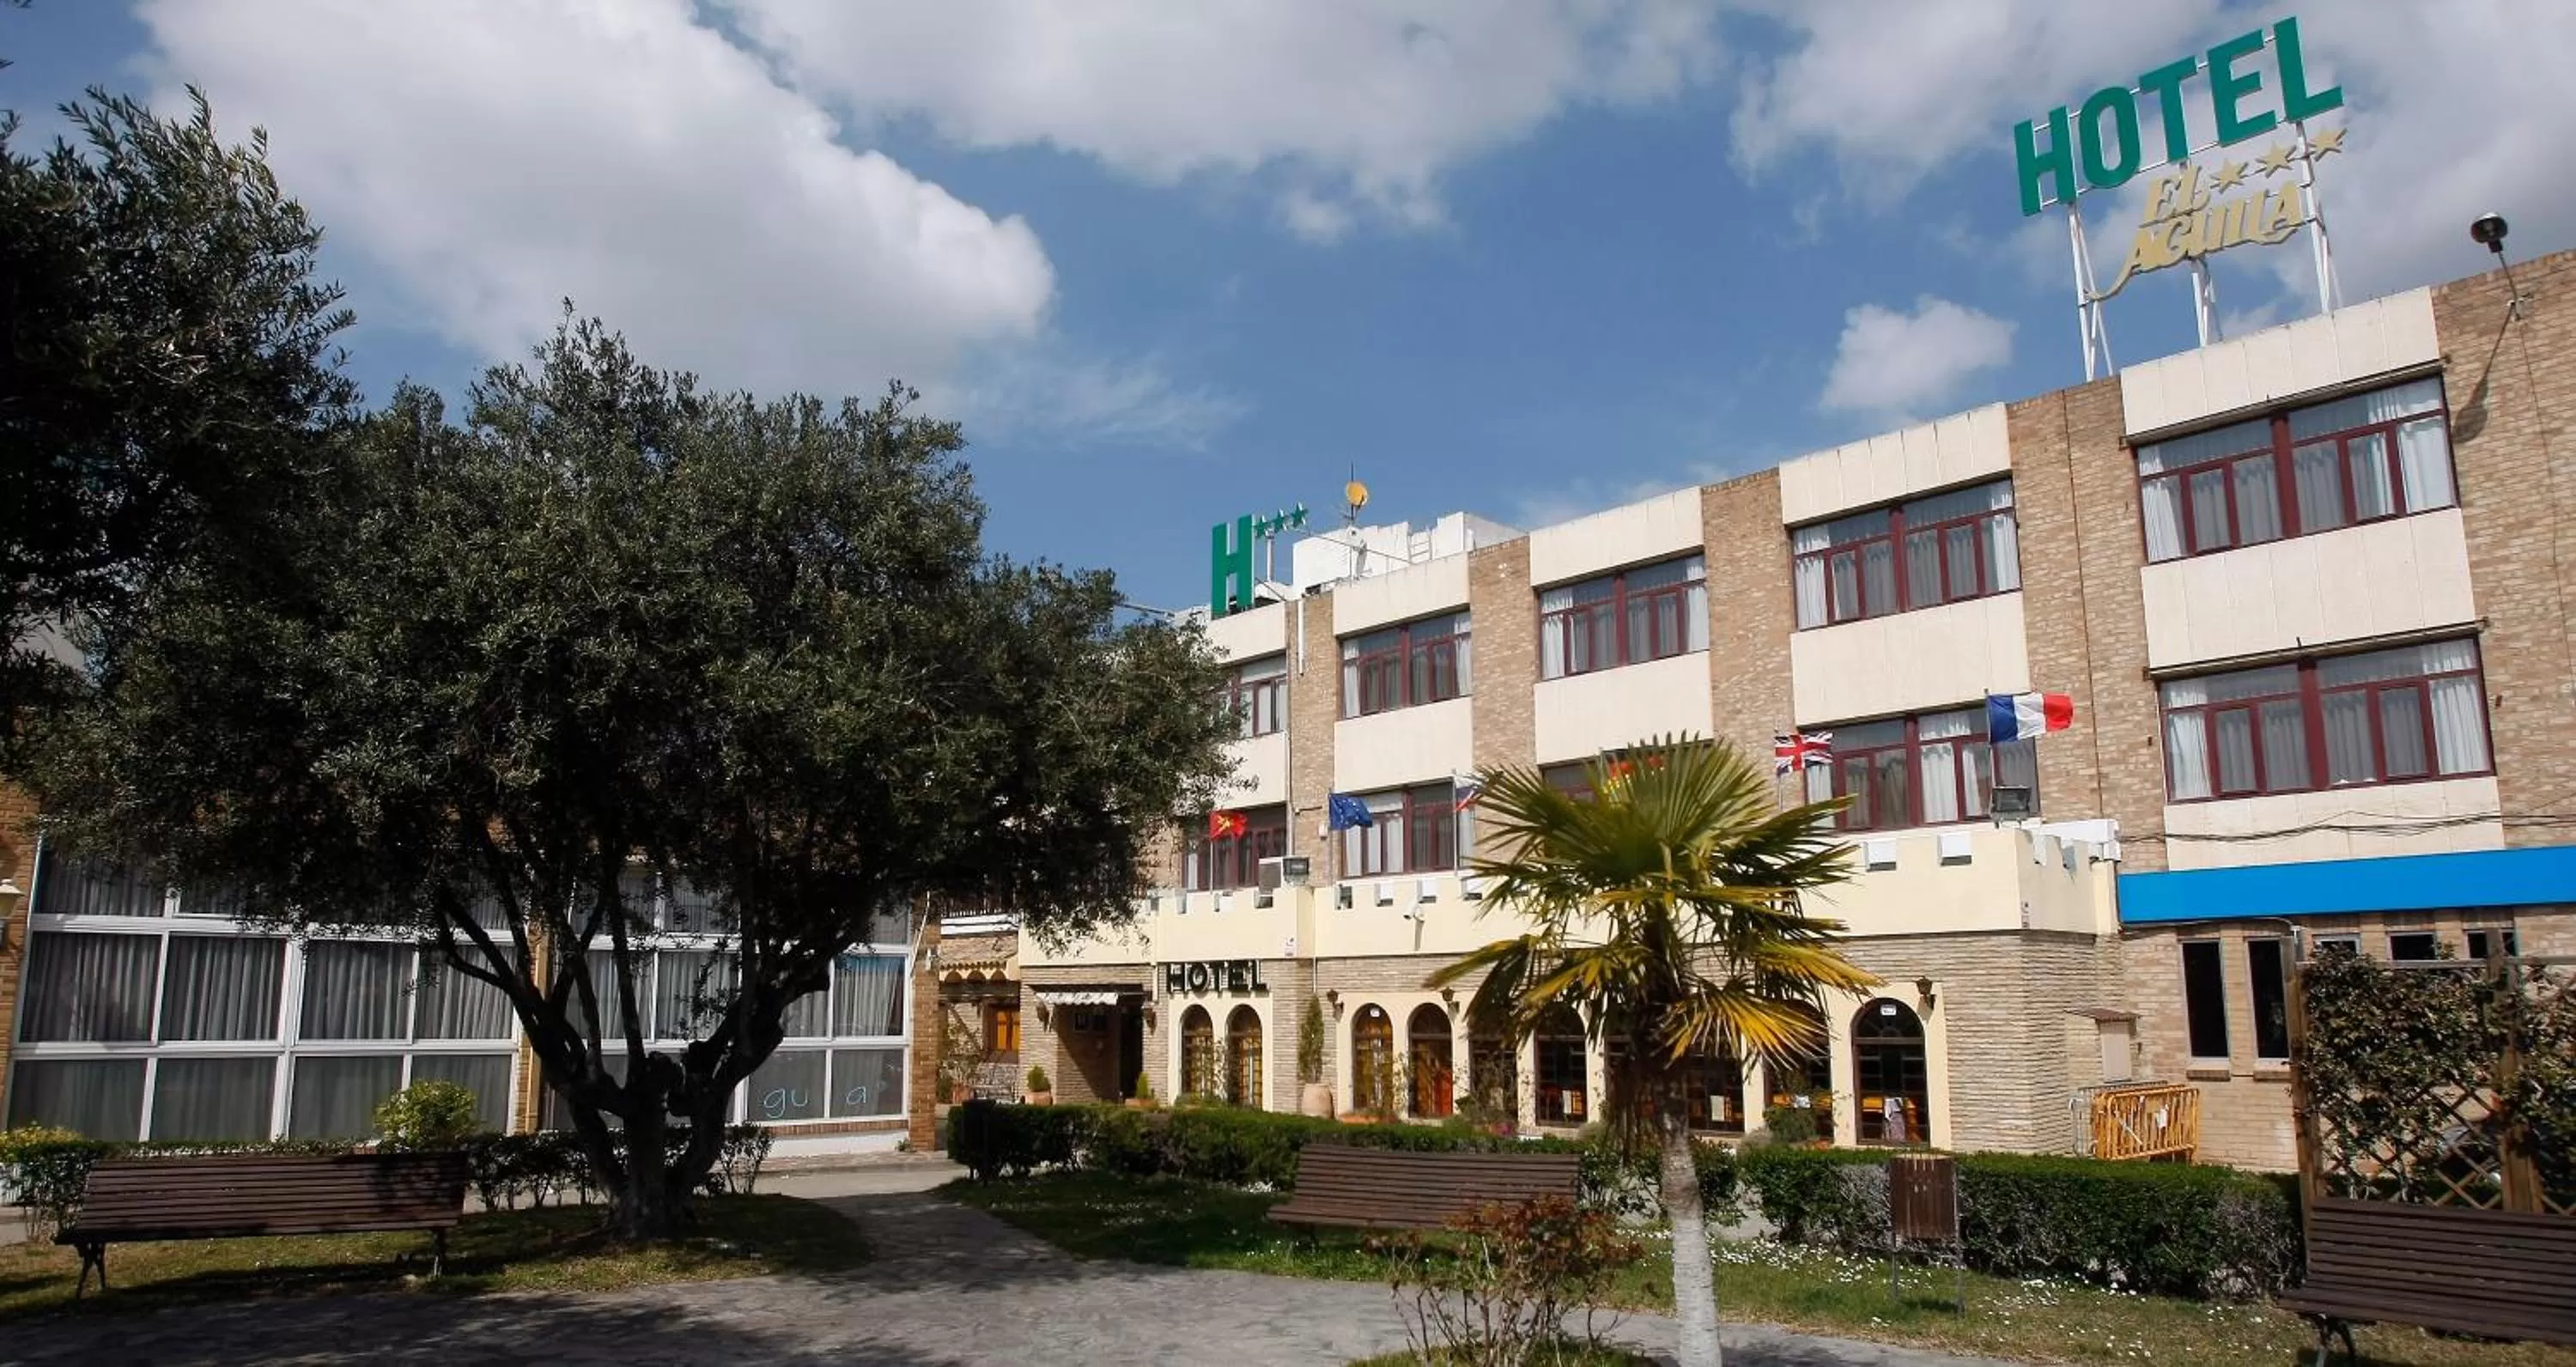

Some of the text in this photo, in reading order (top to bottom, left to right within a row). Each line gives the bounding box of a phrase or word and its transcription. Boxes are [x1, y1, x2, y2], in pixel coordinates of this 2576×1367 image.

[2014, 15, 2344, 217] HOTEL
[2100, 180, 2306, 288] AGUILA
[1211, 514, 1255, 620] H
[1166, 959, 1269, 994] HOTEL
